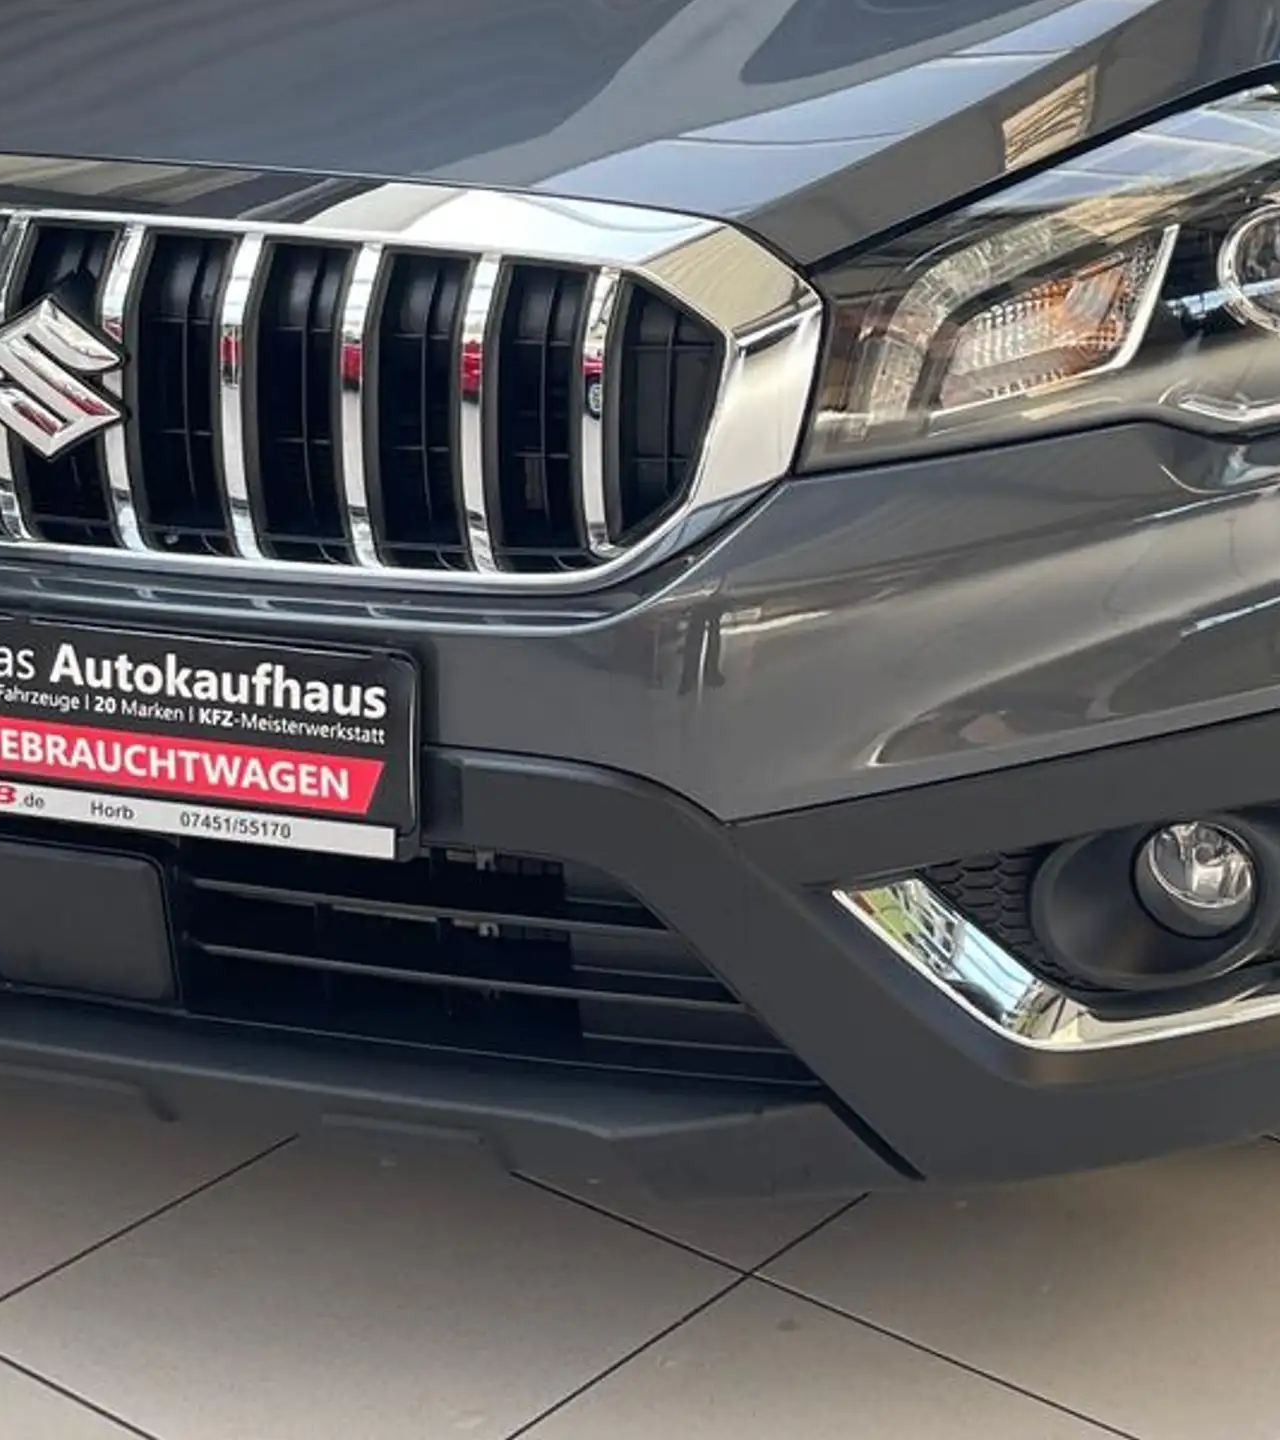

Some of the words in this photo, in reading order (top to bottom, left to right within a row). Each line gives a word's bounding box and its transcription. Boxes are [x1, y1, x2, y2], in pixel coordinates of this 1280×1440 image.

[49, 642, 388, 720] Autokaufhaus
[93, 694, 117, 714] 20
[121, 698, 185, 723] Marken
[197, 706, 386, 746] KFZ-Meisterwerkstatt
[89, 800, 135, 820] Horb
[179, 810, 292, 839] 07451/55170
